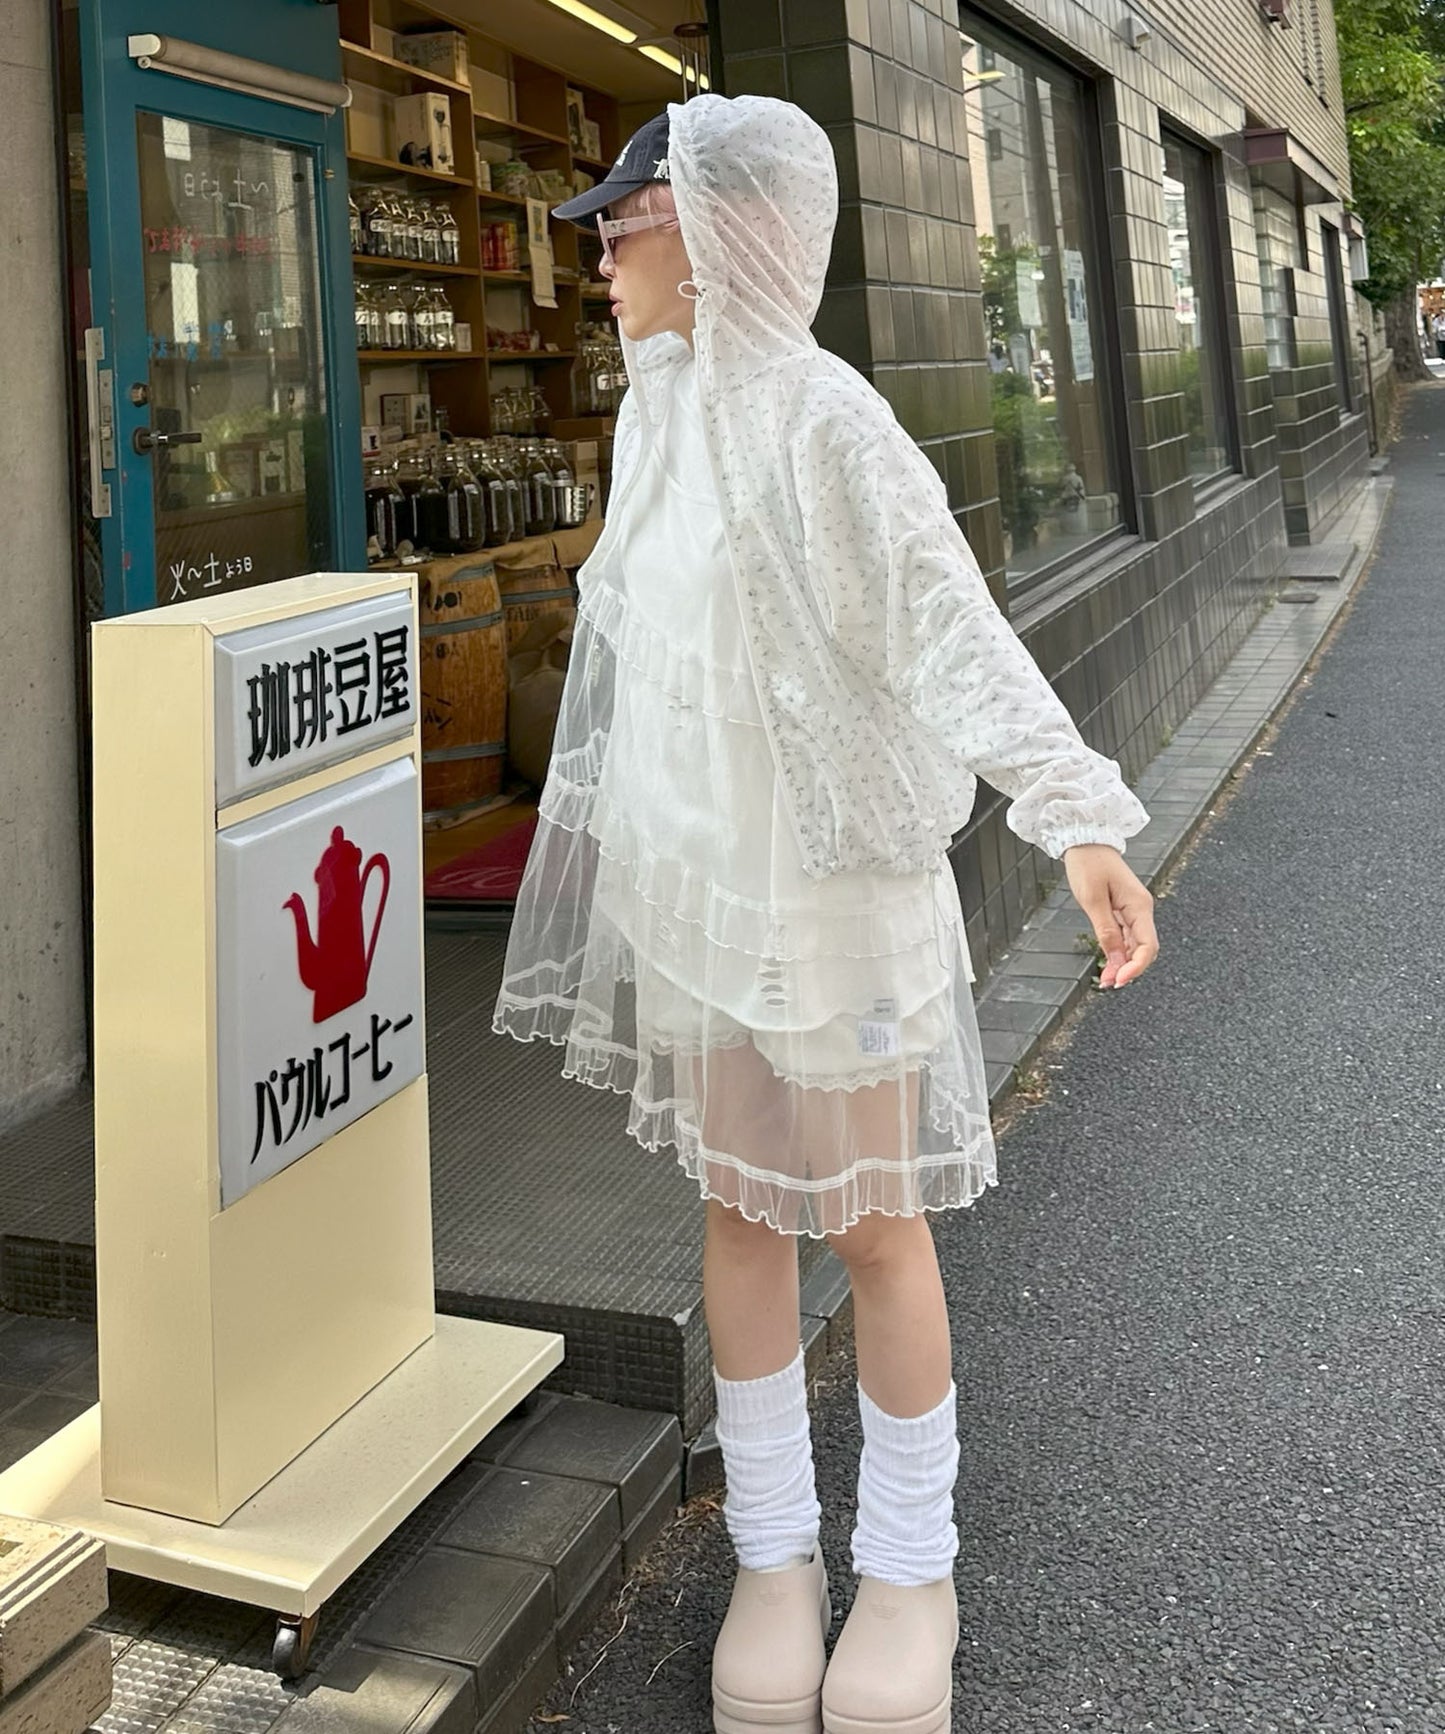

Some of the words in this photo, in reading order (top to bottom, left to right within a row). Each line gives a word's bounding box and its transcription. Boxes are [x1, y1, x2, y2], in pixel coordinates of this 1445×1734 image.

[246, 624, 410, 768] 珈琲豆屋
[251, 1013, 413, 1164] パウルコーヒー
